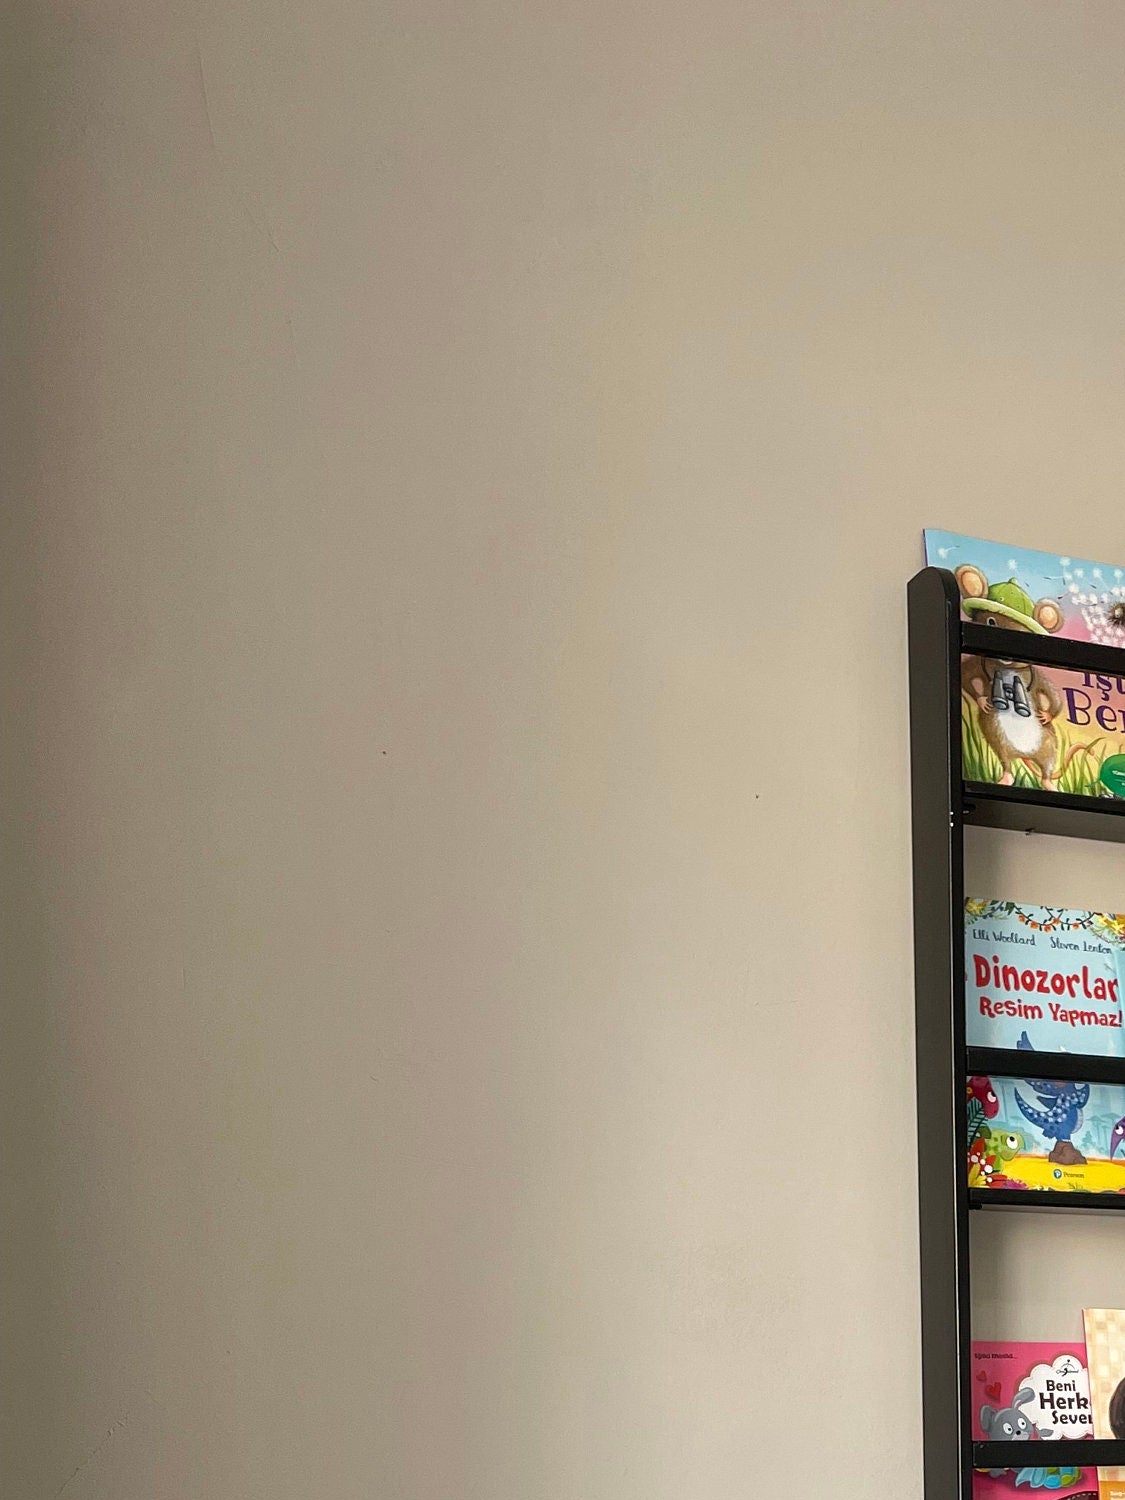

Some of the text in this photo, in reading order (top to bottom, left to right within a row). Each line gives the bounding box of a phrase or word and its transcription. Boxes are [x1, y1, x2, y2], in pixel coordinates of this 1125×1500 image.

[973, 929, 990, 941] Elli
[973, 953, 1118, 1003] Dinozorlar
[979, 996, 1123, 1028] Resim Yapmaz!
[1046, 1380, 1076, 1392] Beni
[1039, 1392, 1090, 1410] Herk
